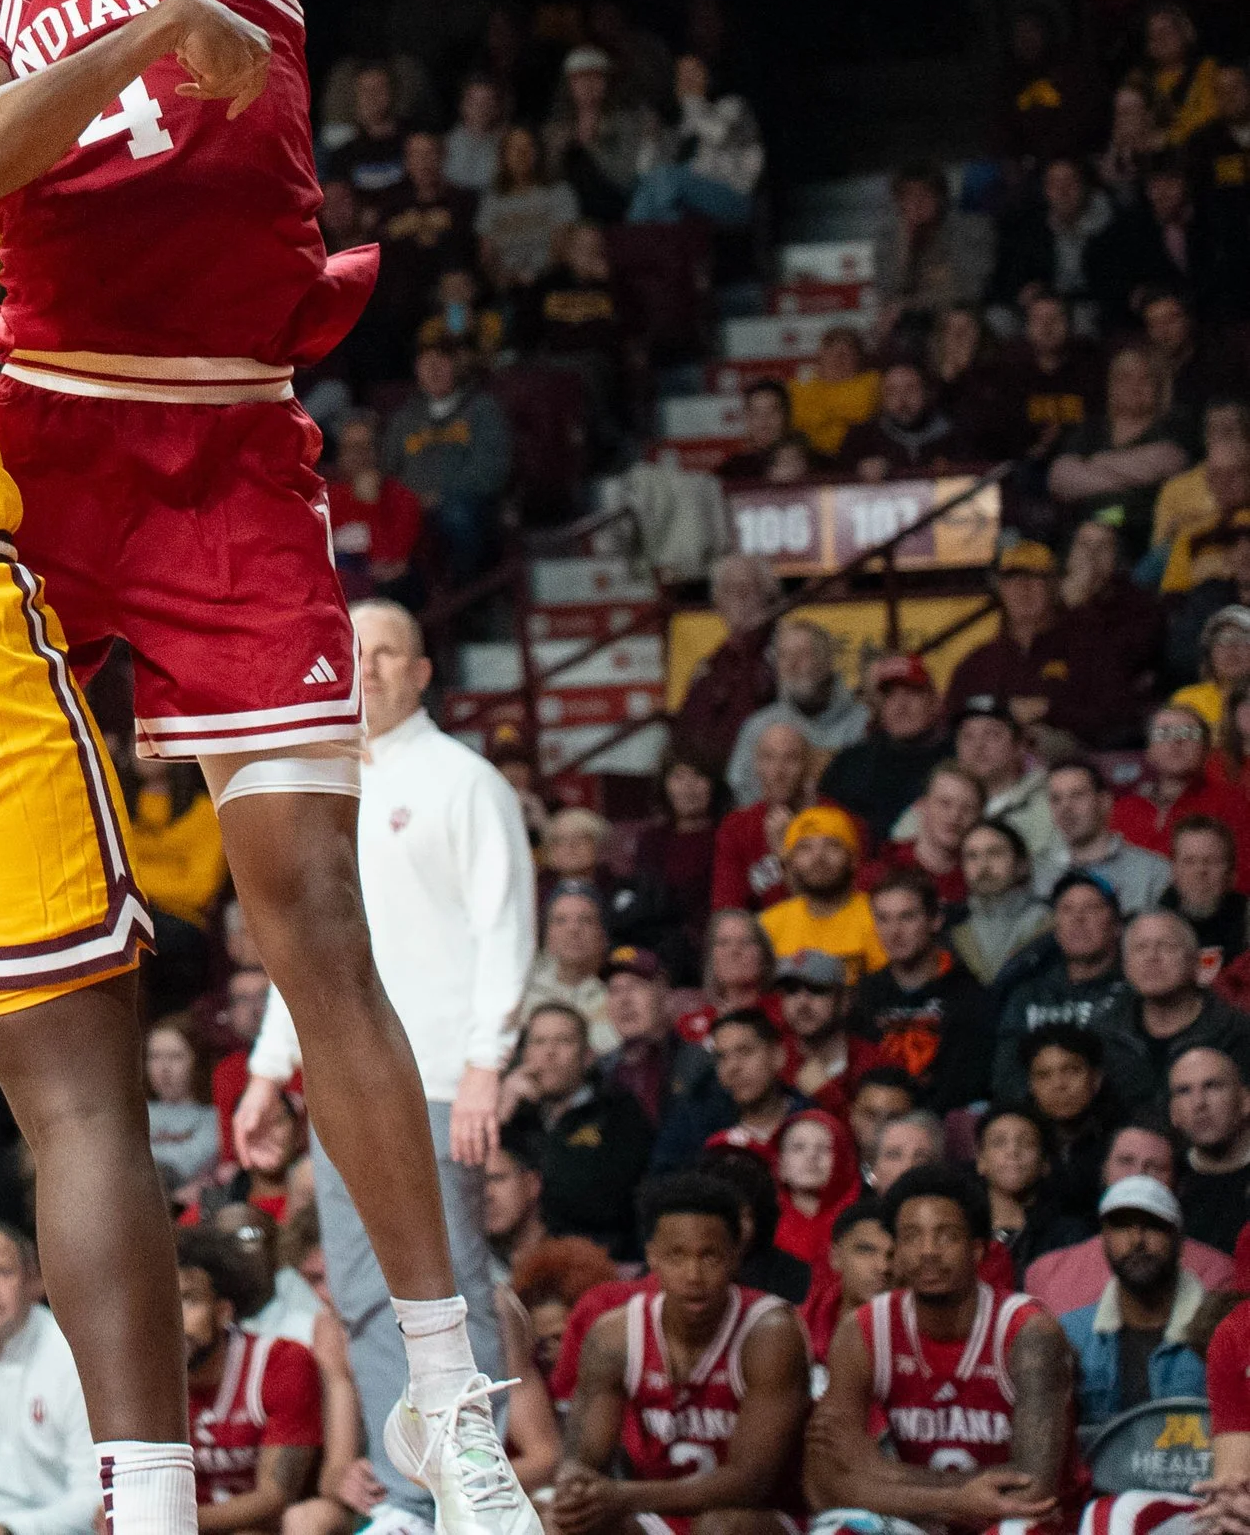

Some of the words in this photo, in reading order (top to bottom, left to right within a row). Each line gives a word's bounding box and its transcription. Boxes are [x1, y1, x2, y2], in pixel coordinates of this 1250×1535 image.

[78, 75, 174, 159] 4
[889, 1405, 1013, 1445] INDIANA
[1131, 1450, 1214, 1476] HEALT
